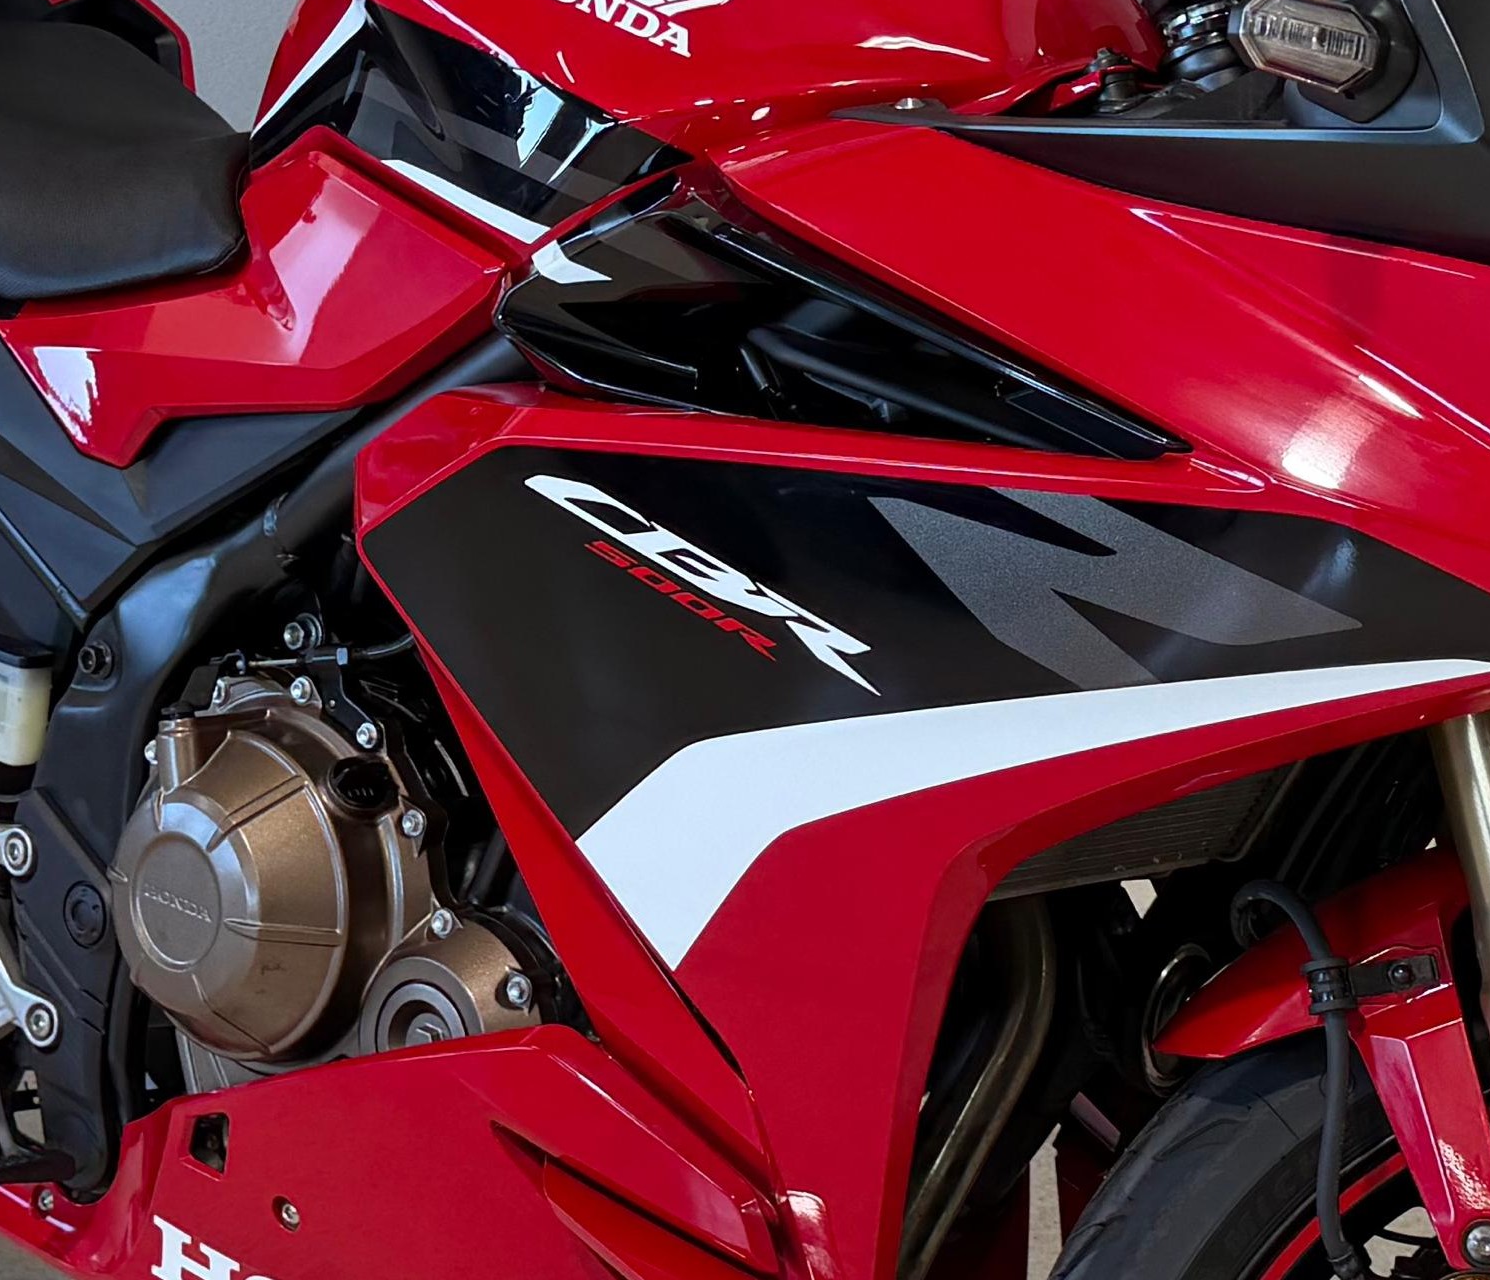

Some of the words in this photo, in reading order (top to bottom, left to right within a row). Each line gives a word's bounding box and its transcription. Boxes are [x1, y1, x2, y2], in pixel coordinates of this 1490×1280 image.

[523, 473, 881, 697] CBR
[584, 540, 778, 663] 500R
[143, 883, 212, 924] HONDA
